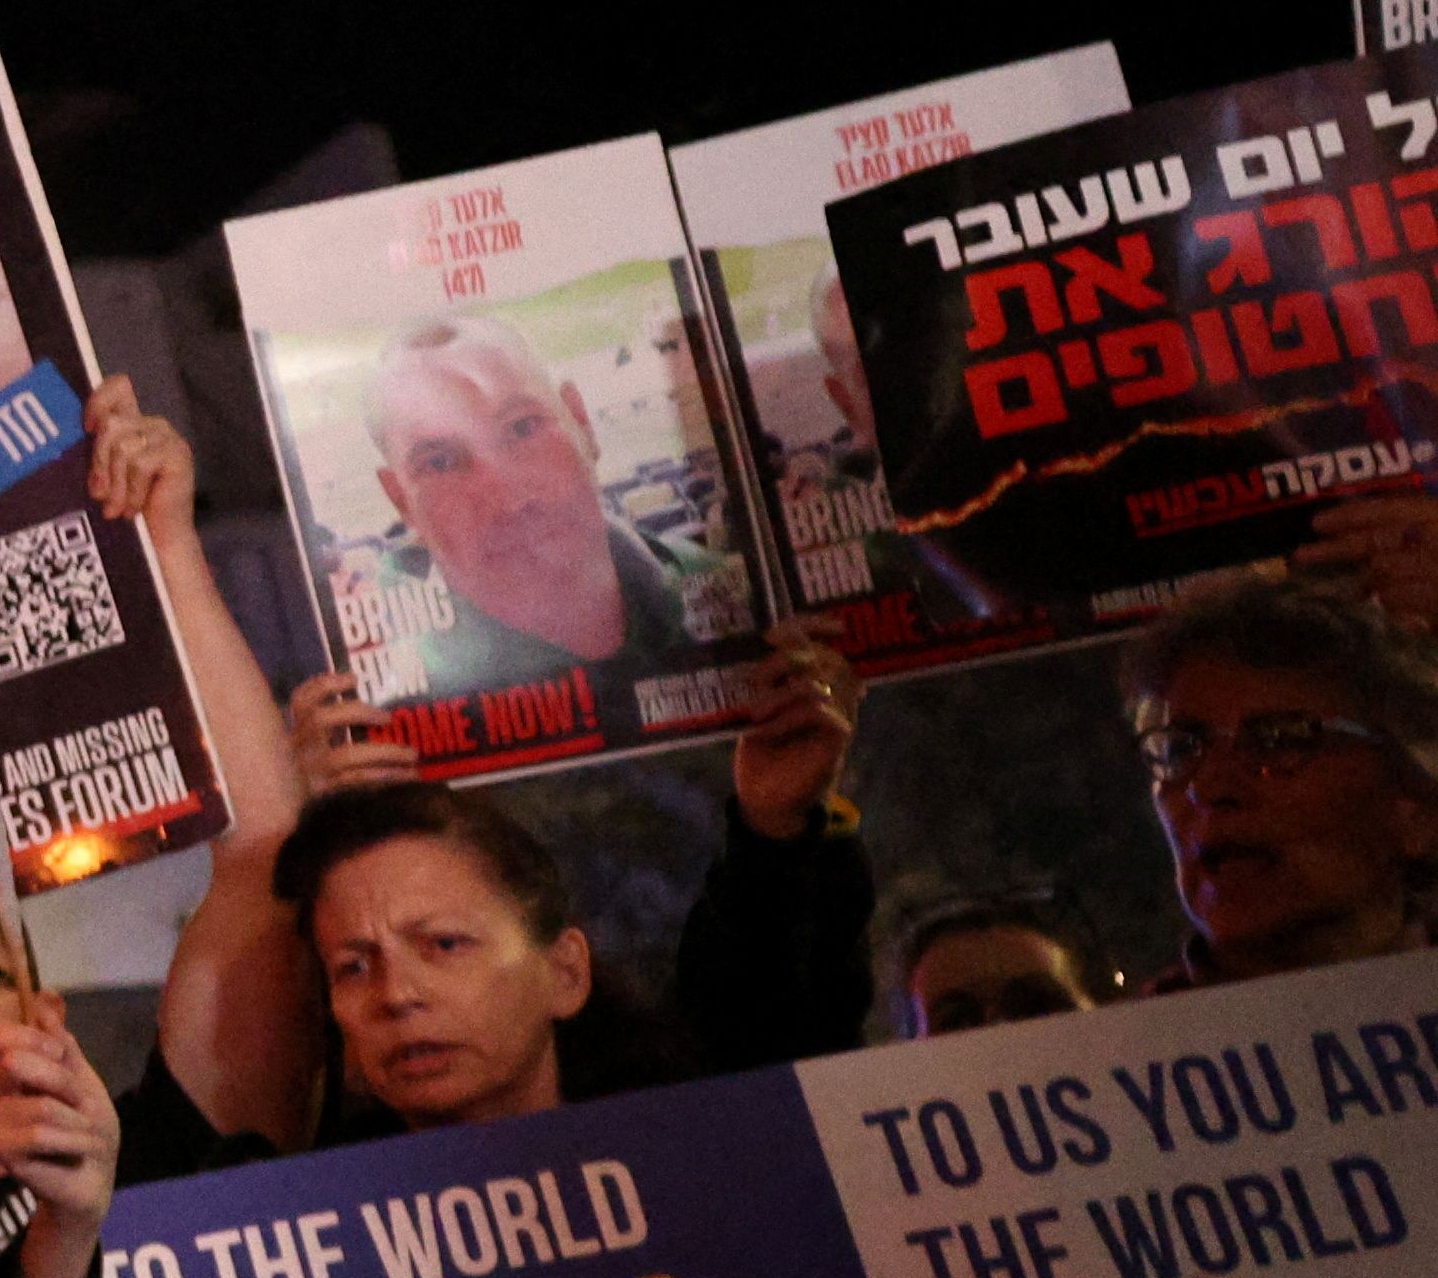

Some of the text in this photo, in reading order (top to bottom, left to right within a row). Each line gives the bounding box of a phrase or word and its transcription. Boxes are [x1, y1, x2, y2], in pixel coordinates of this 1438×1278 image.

[1216, 120, 1346, 199] יום
[447, 220, 524, 261] KATZIR
[903, 155, 1192, 271] שעובר
[964, 231, 1167, 350] את
[336, 576, 457, 647] BRING
[794, 539, 875, 604] HIM
[481, 665, 599, 747] NOW!
[3, 742, 56, 793] AND
[53, 707, 171, 776] MISSING
[50, 746, 190, 838] FORUM
[863, 1099, 984, 1197] TO
[988, 1076, 1112, 1176] US
[1111, 1042, 1297, 1152] YOU
